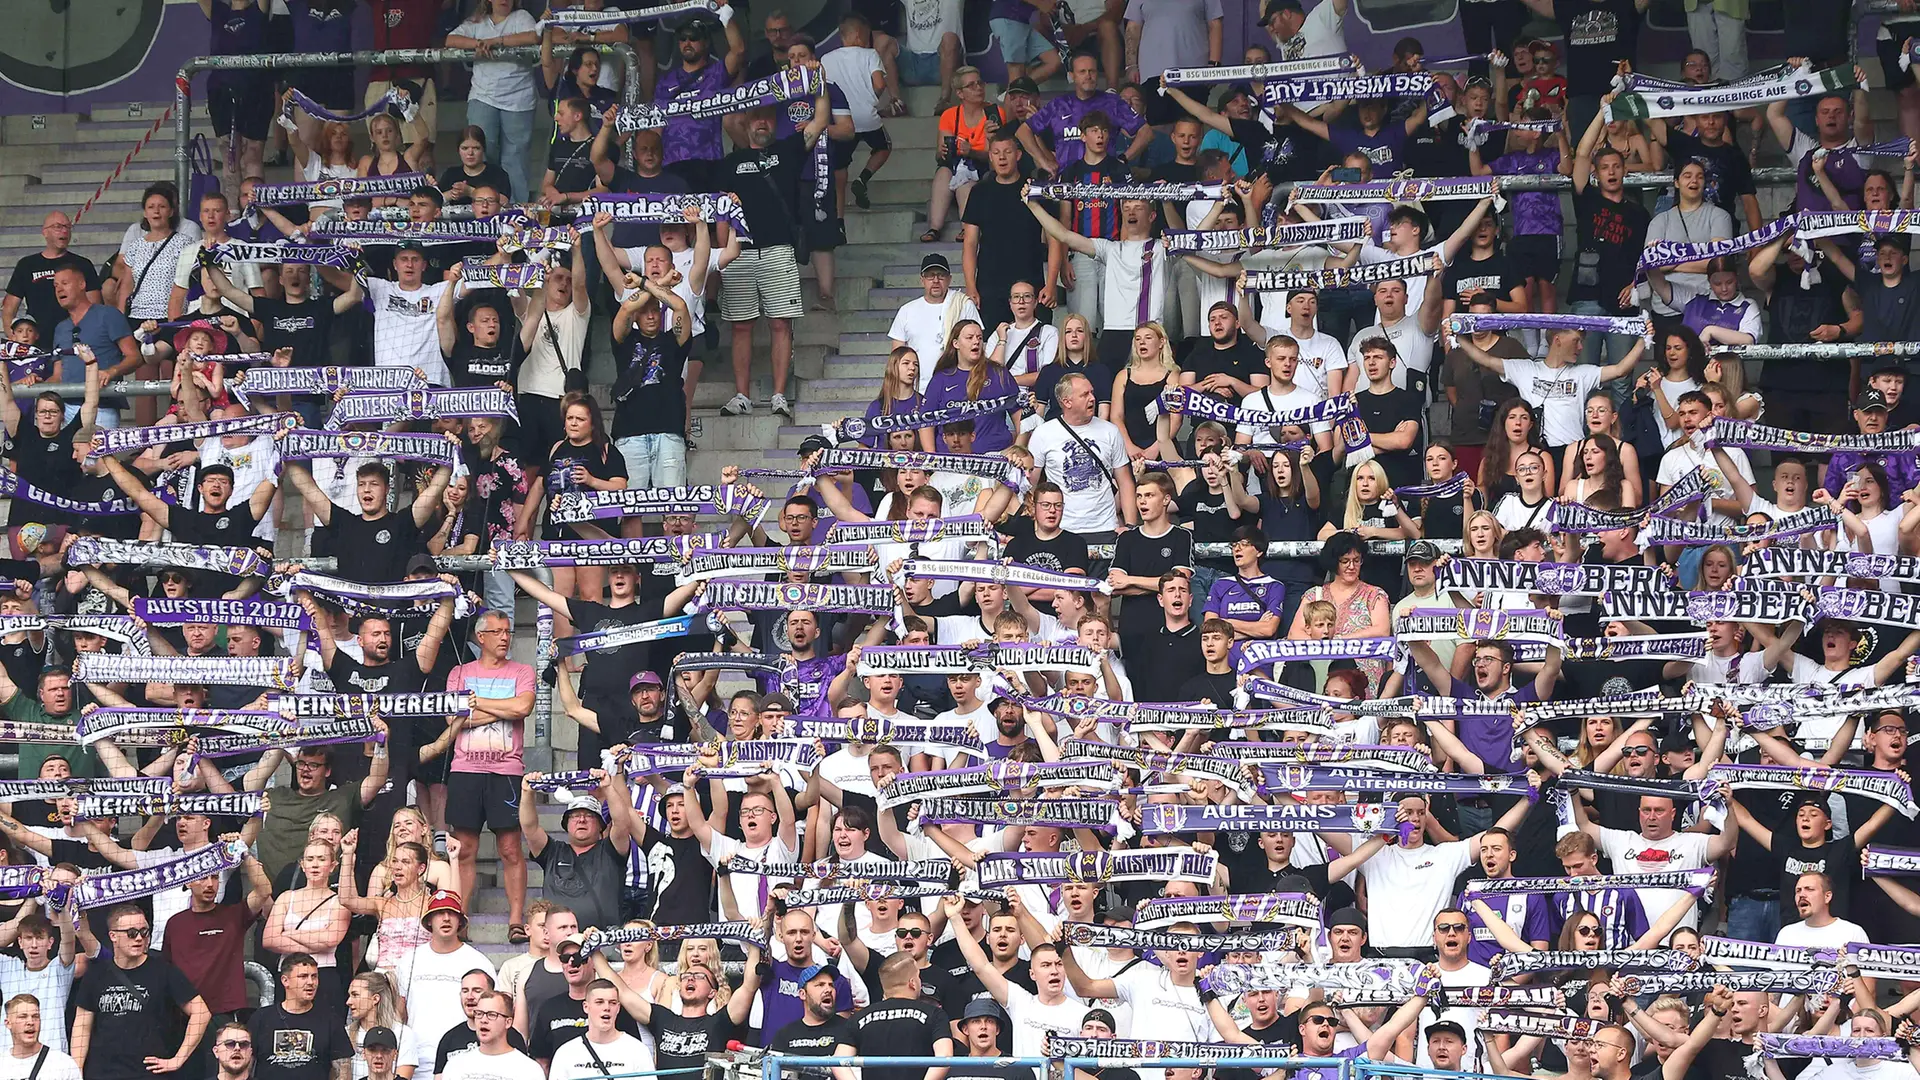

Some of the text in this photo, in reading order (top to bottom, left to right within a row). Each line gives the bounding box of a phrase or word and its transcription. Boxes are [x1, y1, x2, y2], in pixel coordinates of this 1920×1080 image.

[1186, 67, 1246, 79] BSG WISMUT AUE
[1254, 66, 1265, 76] 80
[1270, 59, 1337, 73] FC ERZGEBIRGE AUE
[666, 77, 770, 114] Brigade O/S
[791, 86, 804, 94] AUE
[1264, 75, 1433, 101] BSG WISMUT AUE
[1683, 85, 1788, 106] FC ERZGEBIRGE AUE
[691, 98, 761, 120] Wismut Aue
[1085, 200, 1108, 211] Spotify
[1812, 215, 1833, 229] MEIN
[1875, 221, 1889, 229] AUE
[1203, 229, 1239, 249] SIND
[1280, 222, 1335, 241] WISMUT
[1643, 221, 1777, 265] BSG WISMUT
[234, 243, 338, 263] WISMUT
[1256, 258, 1424, 291] MEIN VEREIN
[468, 363, 505, 374] BLOCK
[1187, 397, 1313, 425] BSG WISMUT
[107, 423, 210, 449] EIN LEBEN
[1714, 419, 1747, 444] WIR
[596, 485, 713, 507] Brigade O/S
[622, 503, 699, 515] Wismut Aue
[843, 525, 892, 541] MEIN HERZ
[1652, 518, 1682, 541] WIR
[548, 538, 669, 559] Brigade O/S
[575, 556, 654, 566] Wismut Aue
[693, 554, 729, 572] GEHÖRT
[730, 553, 753, 568] MEIN
[754, 552, 777, 567] HERZ
[794, 562, 809, 570] AUE
[830, 551, 846, 566] EIN
[1745, 550, 1847, 578] ANNA
[921, 563, 986, 575] BSG WISMUT AUE
[1012, 569, 1021, 579] FC
[1439, 560, 1538, 590] ANNA
[146, 600, 302, 620] AUFSTIEG 2010
[1227, 602, 1260, 612] MBR
[186, 614, 300, 629] ...DO SEI MER WIEDER!
[1410, 616, 1457, 633] MEIN HERZ
[1509, 616, 1550, 633] EIN LEBEN
[579, 621, 686, 649] FREUNDSCHAFTSSPIEL
[1473, 628, 1488, 636] AUE
[864, 650, 967, 669] WISMUT AUE
[995, 649, 1093, 667] NUR DU ALLEIN
[1244, 639, 1373, 666] ERZGEBIRGE
[1256, 684, 1266, 692] FC
[280, 692, 458, 716] MEIN VEREIN
[1165, 709, 1189, 725] MEIN
[802, 720, 847, 739] SIND
[895, 725, 926, 742] DER
[736, 742, 797, 762] WISMUT
[1088, 743, 1111, 758] MEIN
[1242, 746, 1295, 759] MEIN HERZ
[1040, 765, 1113, 781] EIN LEBEN LANG!
[1151, 761, 1166, 769] AUE
[1186, 757, 1232, 780] EIN LEBEN
[898, 772, 986, 796] GEHÖRT MEIN HERZ
[1005, 779, 1020, 787] AUE
[1342, 780, 1447, 791] ALTENBURG
[1809, 780, 1824, 789] AUE
[1847, 775, 1893, 797] EIN LEBEN
[84, 794, 256, 817] MEIN VEREIN
[1201, 804, 1336, 819] AUE-FANS
[1217, 819, 1320, 831] ALTENBURG
[102, 848, 223, 898] LEBEN LANG!
[979, 858, 1065, 884] WIR SIND
[1111, 853, 1178, 875] WISMUT
[1083, 870, 1095, 878] AUE
[1169, 900, 1221, 916] MEIN HERZ
[1239, 909, 1256, 919] AUE
[1279, 901, 1296, 917] EIN
[1190, 934, 1260, 953] 1946
[1600, 949, 1668, 970] 1946
[1773, 946, 1813, 965] AUE
[1740, 969, 1813, 992] 1946
[1051, 1040, 1081, 1058] 80
